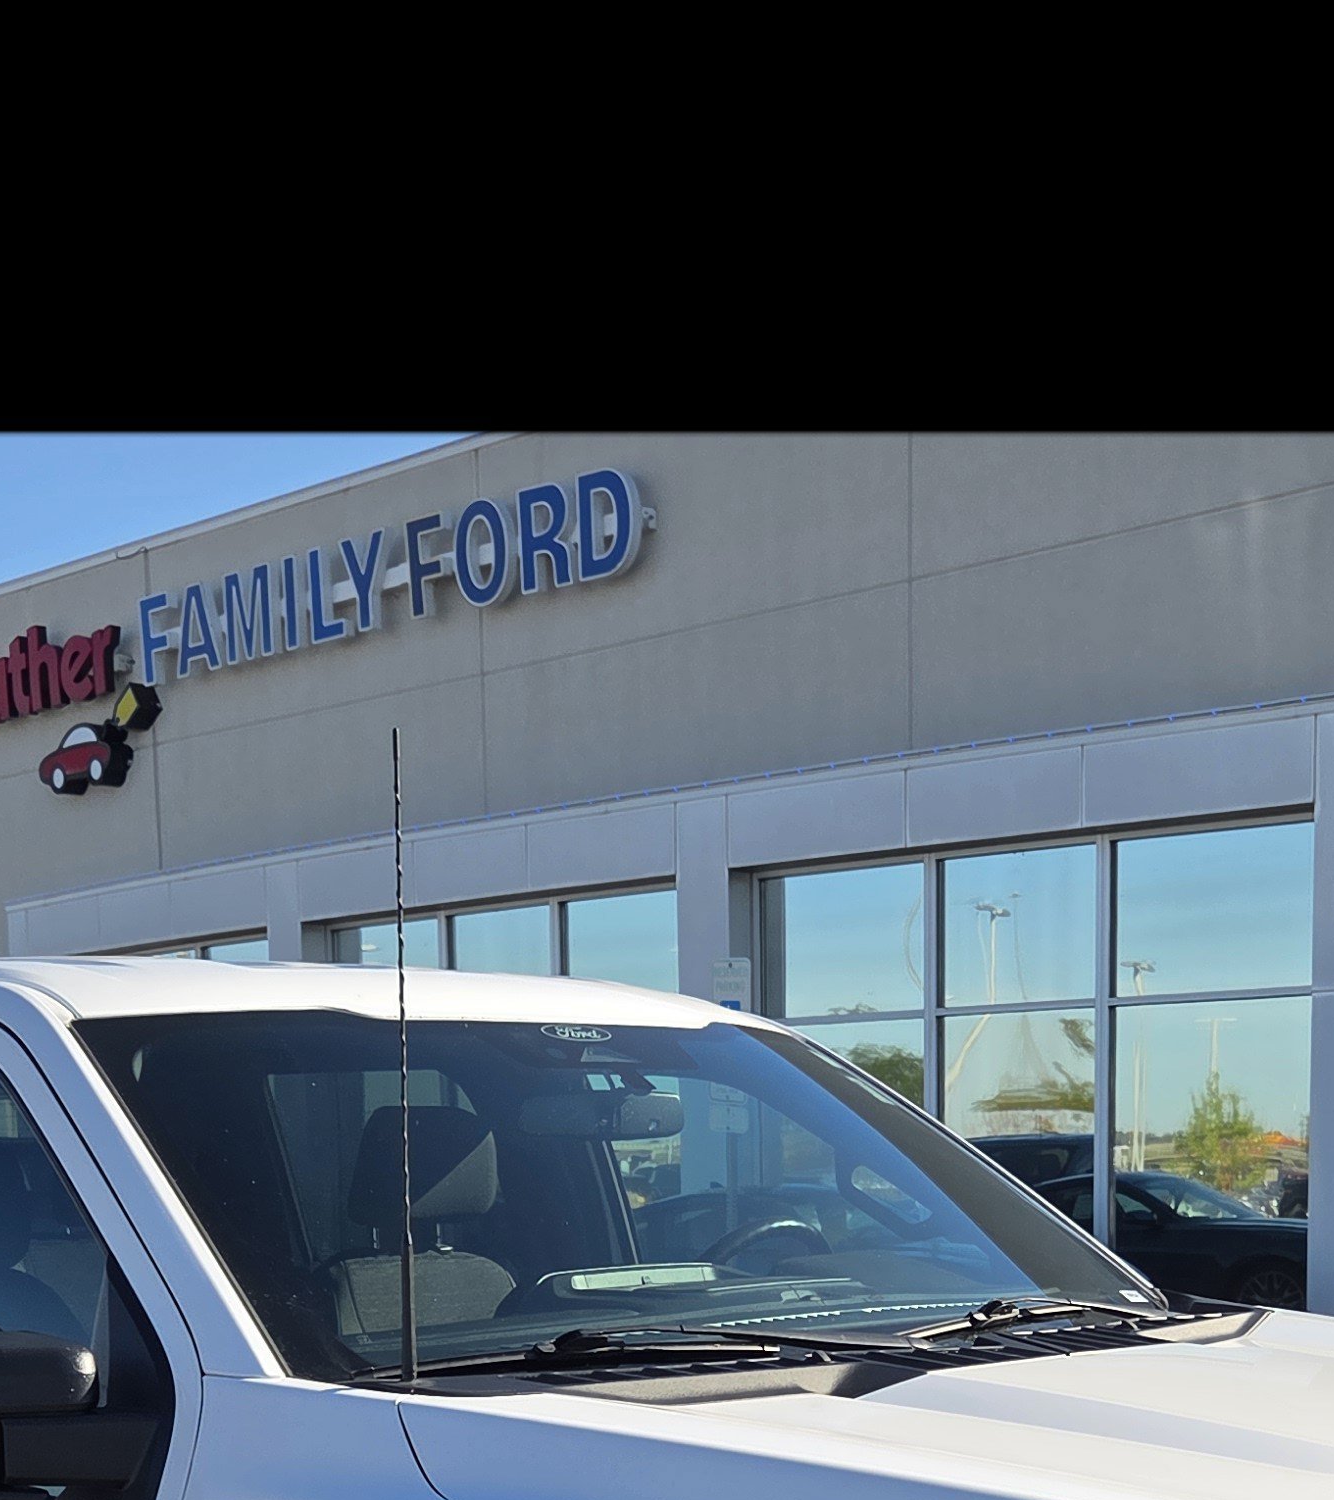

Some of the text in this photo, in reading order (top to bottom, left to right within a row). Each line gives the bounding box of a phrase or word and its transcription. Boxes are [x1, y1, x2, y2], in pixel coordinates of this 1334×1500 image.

[138, 525, 391, 687] FAMILY
[403, 467, 640, 619] FORD
[554, 1025, 602, 1039] Ford
